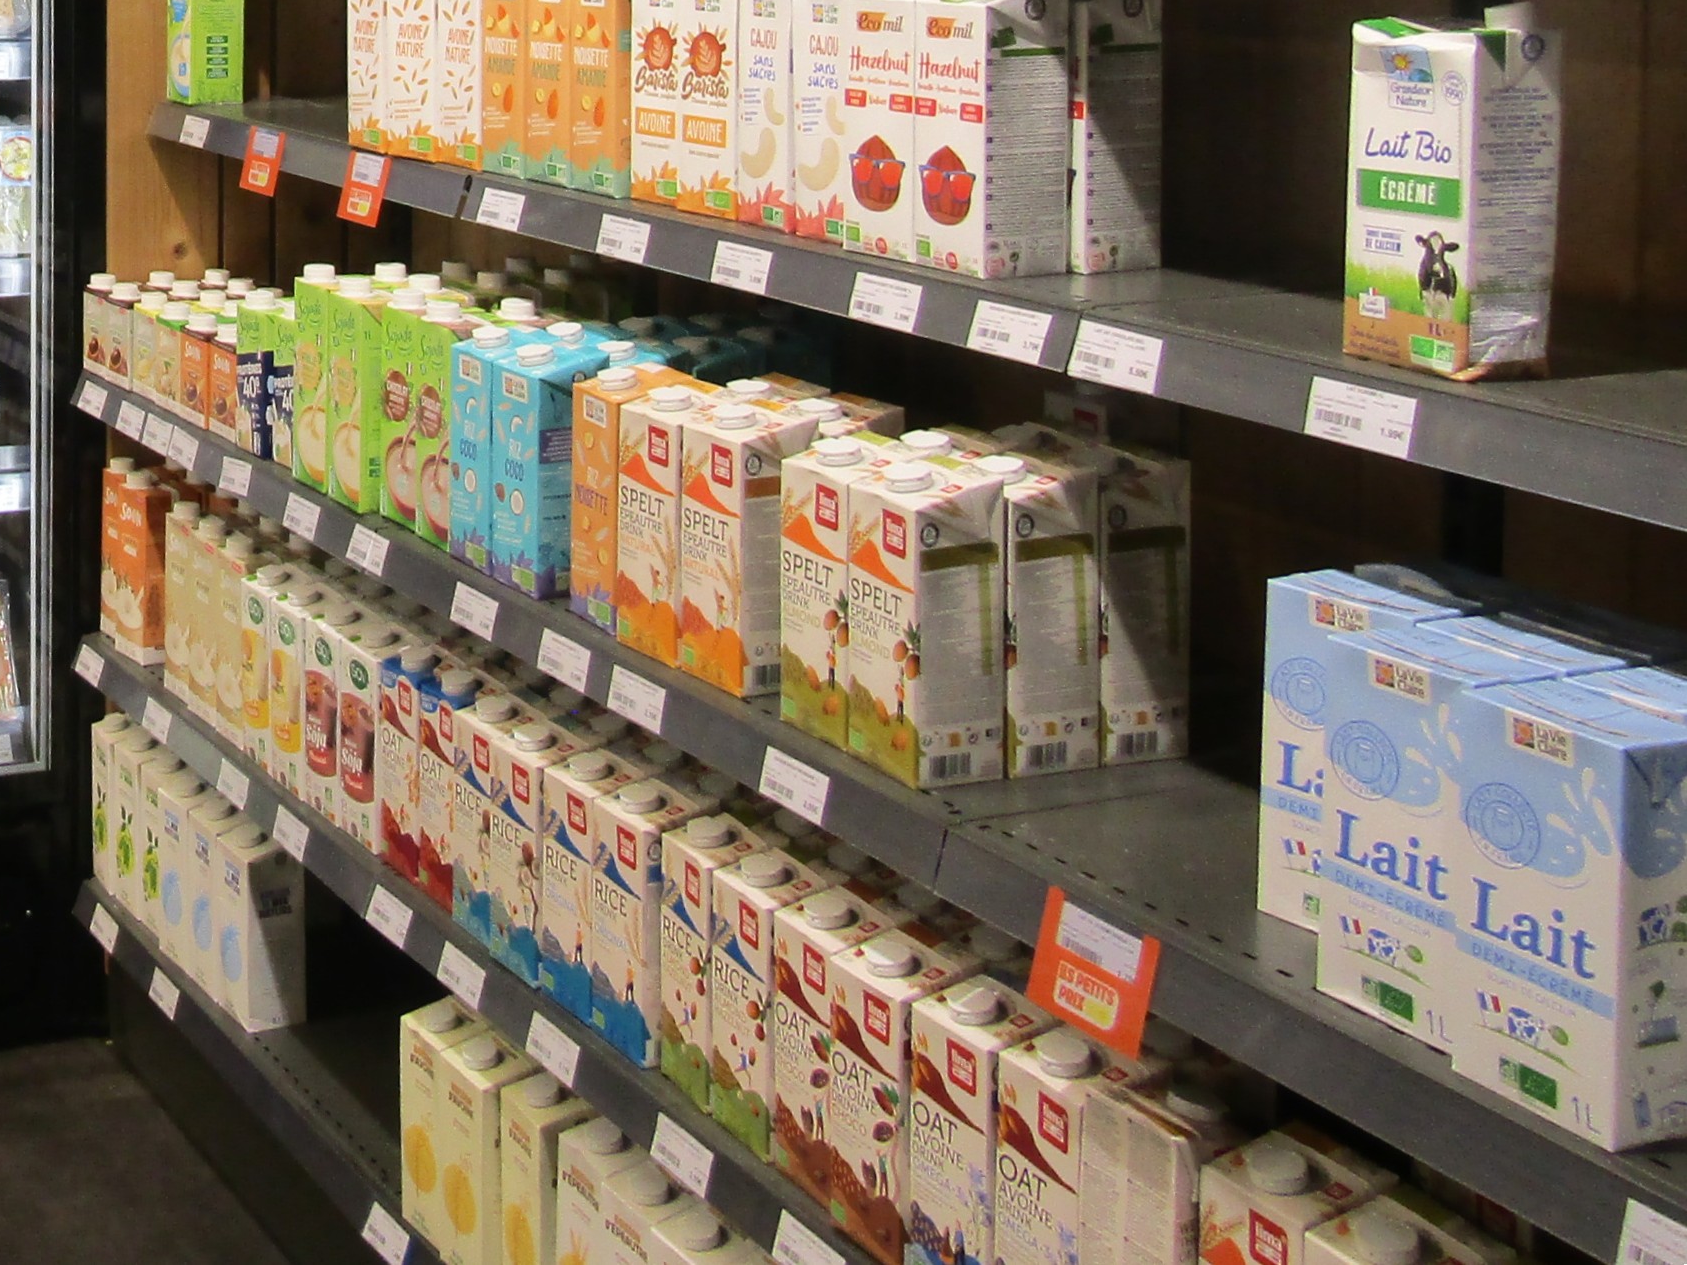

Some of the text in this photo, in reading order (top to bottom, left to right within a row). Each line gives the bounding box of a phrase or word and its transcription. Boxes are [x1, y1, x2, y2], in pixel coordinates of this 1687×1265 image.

[355, 20, 373, 34] AVOINE
[398, 23, 423, 40] AVOINE
[448, 28, 470, 45] AVOINE
[750, 30, 777, 50] CAJOU
[353, 37, 375, 54] NATURE
[396, 41, 424, 59] NATURE
[445, 46, 471, 64] NATURE
[485, 38, 517, 56] NOISETTE
[531, 42, 562, 61] NOISETTE
[574, 46, 608, 67] NOISETTE
[753, 54, 774, 67] sans
[809, 35, 839, 57] CAJOU
[850, 45, 911, 75] Hazelnut
[635, 66, 678, 92] Barista
[748, 67, 776, 82] sucres
[808, 75, 839, 90] sucres
[813, 62, 836, 75] sans
[919, 52, 982, 84] Hazelnut
[681, 70, 729, 100] Barista
[638, 112, 672, 135] AVOINE
[686, 119, 722, 143] AVOINE
[1365, 127, 1452, 164] Lait Bio
[1379, 177, 1436, 206] ÉCRÉMÉ
[620, 485, 665, 519] SPELT
[683, 508, 729, 541] SPELT
[782, 550, 833, 588] SPELT
[851, 578, 902, 616] SPELT
[382, 727, 403, 754] OAT
[421, 753, 444, 780] OAT
[455, 783, 483, 816] RICE
[492, 814, 522, 848] RICE
[545, 845, 577, 882] RICE
[1335, 809, 1449, 902] Lait
[594, 879, 627, 918] RICE
[1335, 870, 1446, 929] DEMI-ÉCRÉMÉ
[663, 915, 692, 962] RICE
[1471, 878, 1596, 980] Lait
[714, 955, 749, 1000] RICE
[1472, 941, 1594, 1007] DEMI-ÉCRÉMÉ
[775, 1001, 810, 1039] OAT
[1426, 1009, 1454, 1044] 1L
[776, 1030, 814, 1063] AVOINE
[832, 1051, 873, 1092] OAT
[832, 1078, 877, 1115] AVOINE
[913, 1101, 957, 1145] OAT
[1571, 1095, 1600, 1135] 1L
[913, 1128, 963, 1170] AVOINE
[913, 1144, 944, 1171] DRINK
[999, 1154, 1048, 1203] OAT
[999, 1181, 1052, 1227] AVOINE
[999, 1198, 1032, 1230] DRINK
